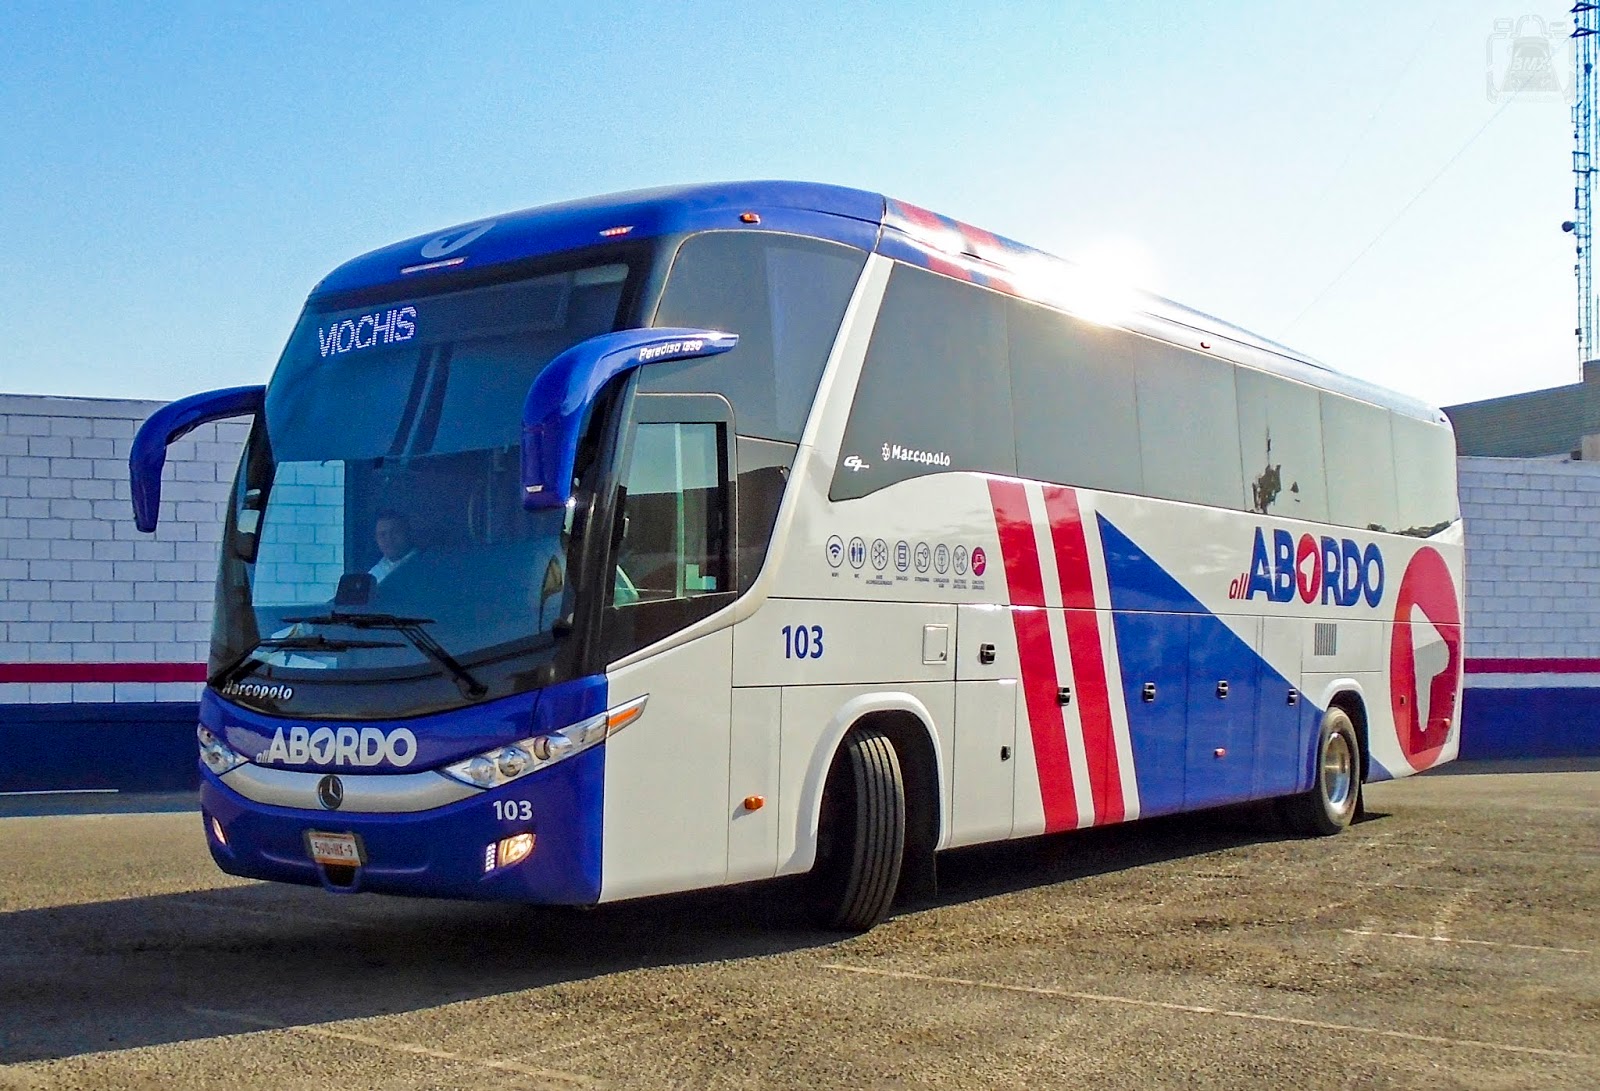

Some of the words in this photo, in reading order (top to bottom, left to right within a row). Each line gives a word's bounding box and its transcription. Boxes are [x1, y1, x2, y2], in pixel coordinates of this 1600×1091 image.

[639, 342, 682, 362] Paradiso
[892, 444, 951, 467] Marcopolo
[1246, 526, 1385, 608] ABORDO
[781, 624, 824, 659] 103
[222, 679, 293, 700] Marcopolo
[269, 726, 418, 767] ABORDO
[492, 800, 533, 821] 103
